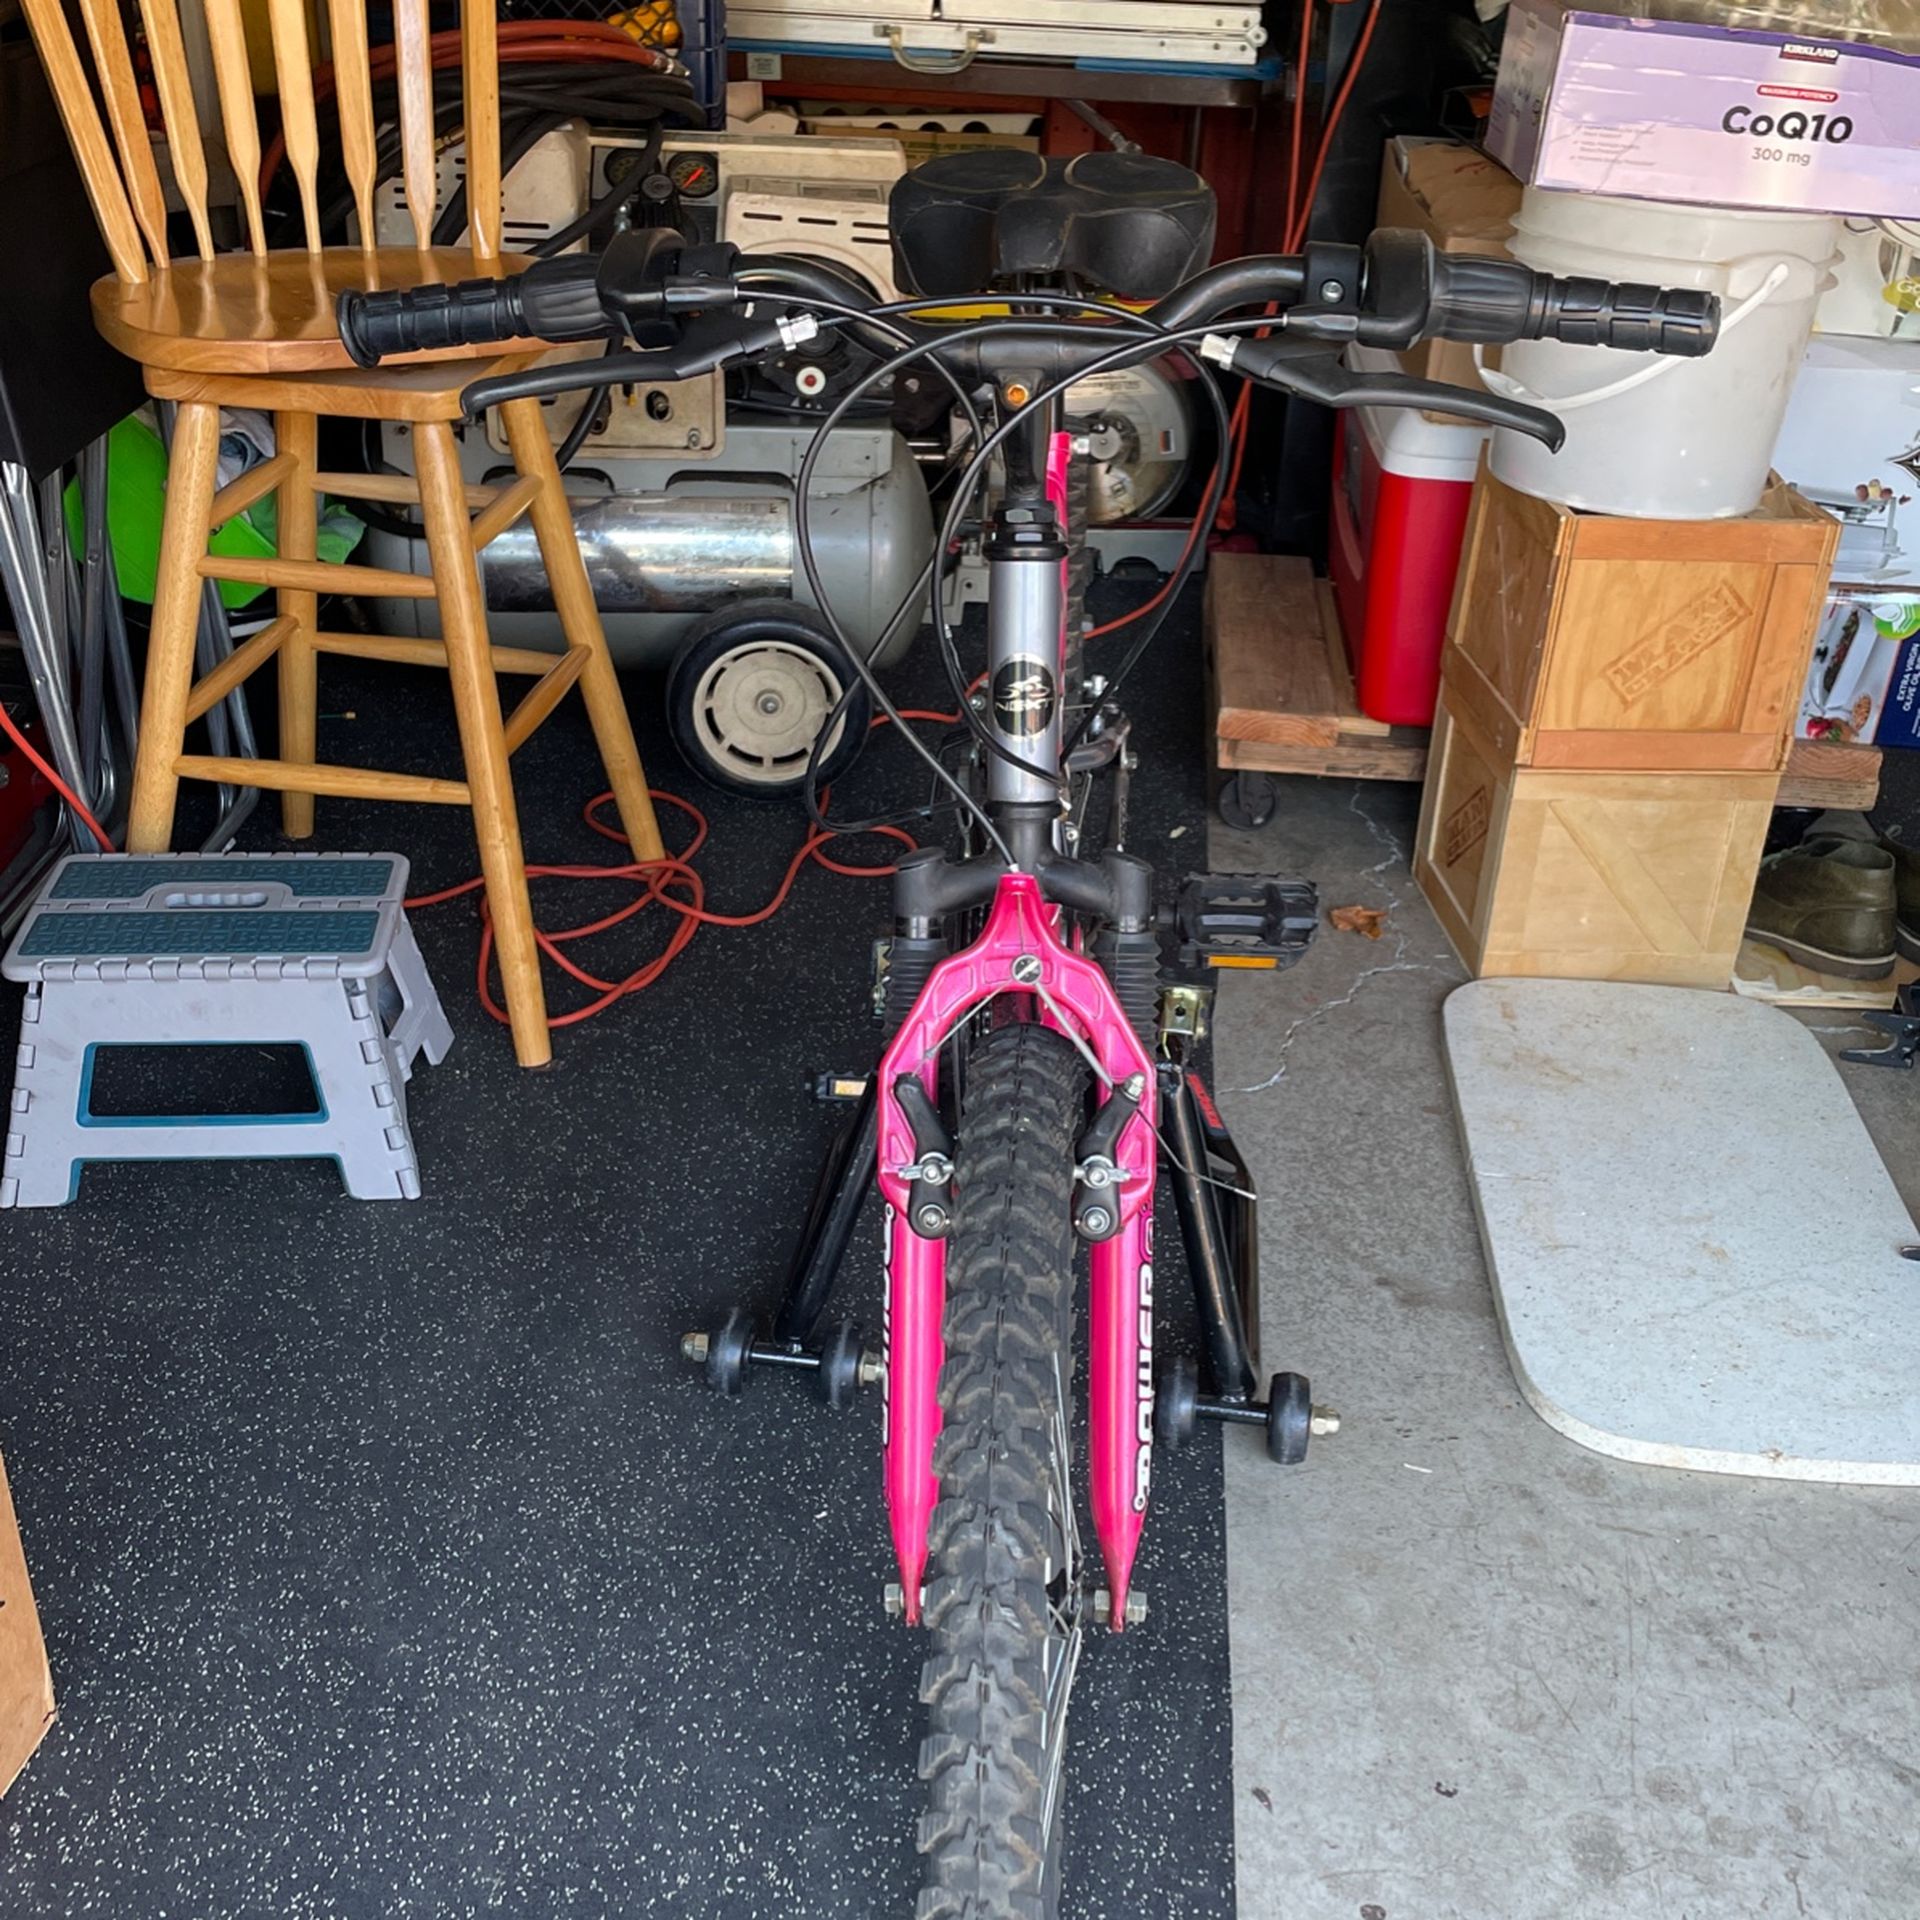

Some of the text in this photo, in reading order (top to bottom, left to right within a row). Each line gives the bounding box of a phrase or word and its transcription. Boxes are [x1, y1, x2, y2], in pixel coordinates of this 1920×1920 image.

[1783, 43, 1838, 59] KIRKLAND
[1722, 105, 1853, 144] CoQ10
[1752, 147, 1811, 167] 300 mg
[1896, 642, 1920, 702] EXTRA VIRGIN
[1902, 687, 1917, 712] OLIVE
